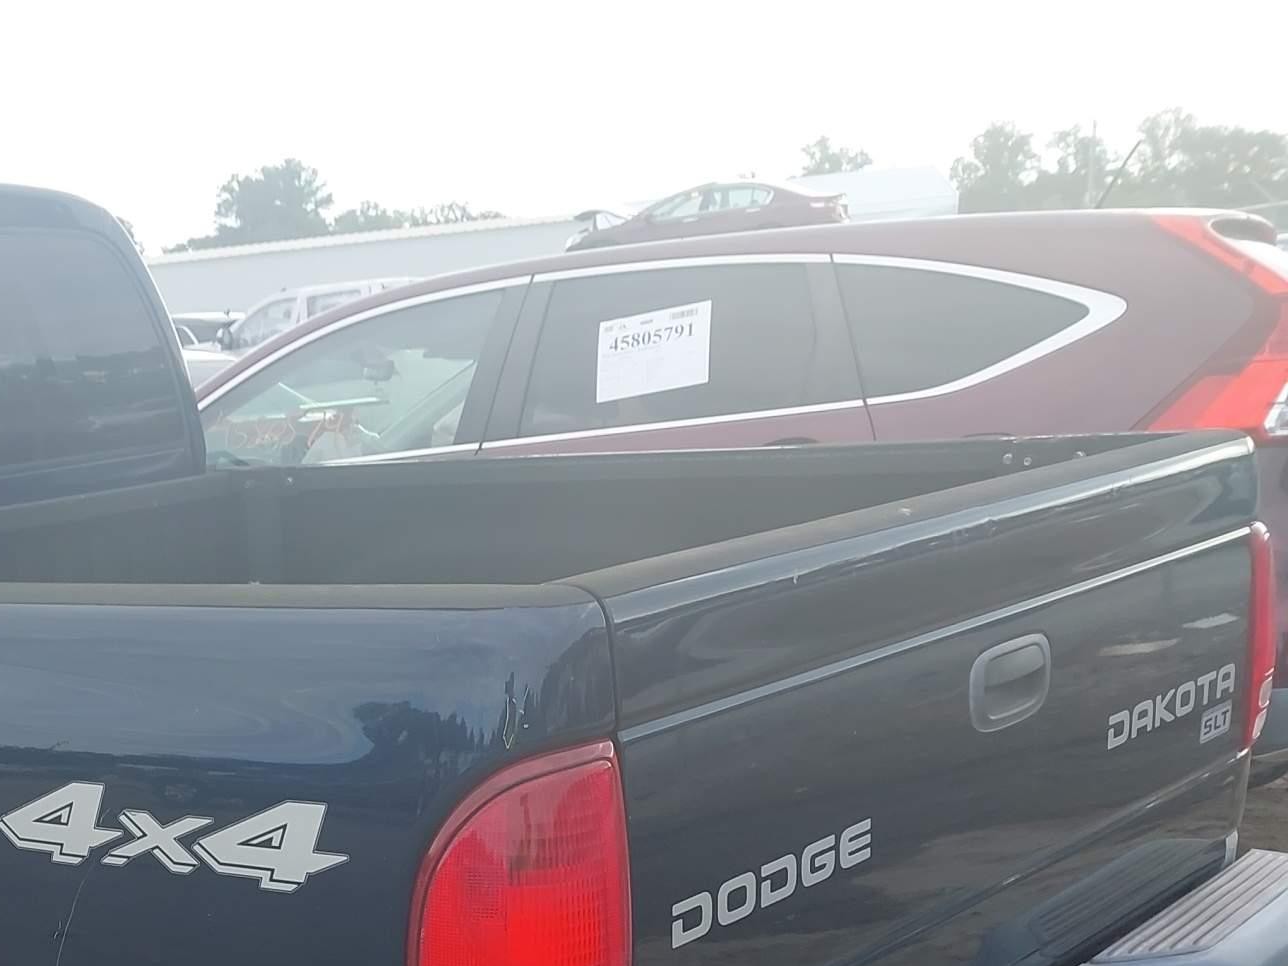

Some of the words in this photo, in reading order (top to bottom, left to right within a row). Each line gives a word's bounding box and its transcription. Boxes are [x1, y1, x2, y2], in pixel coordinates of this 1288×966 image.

[609, 322, 694, 352] 45805791
[1107, 663, 1236, 750] DAKOTA
[1203, 710, 1229, 737] SLT
[671, 817, 872, 949] DODGE
